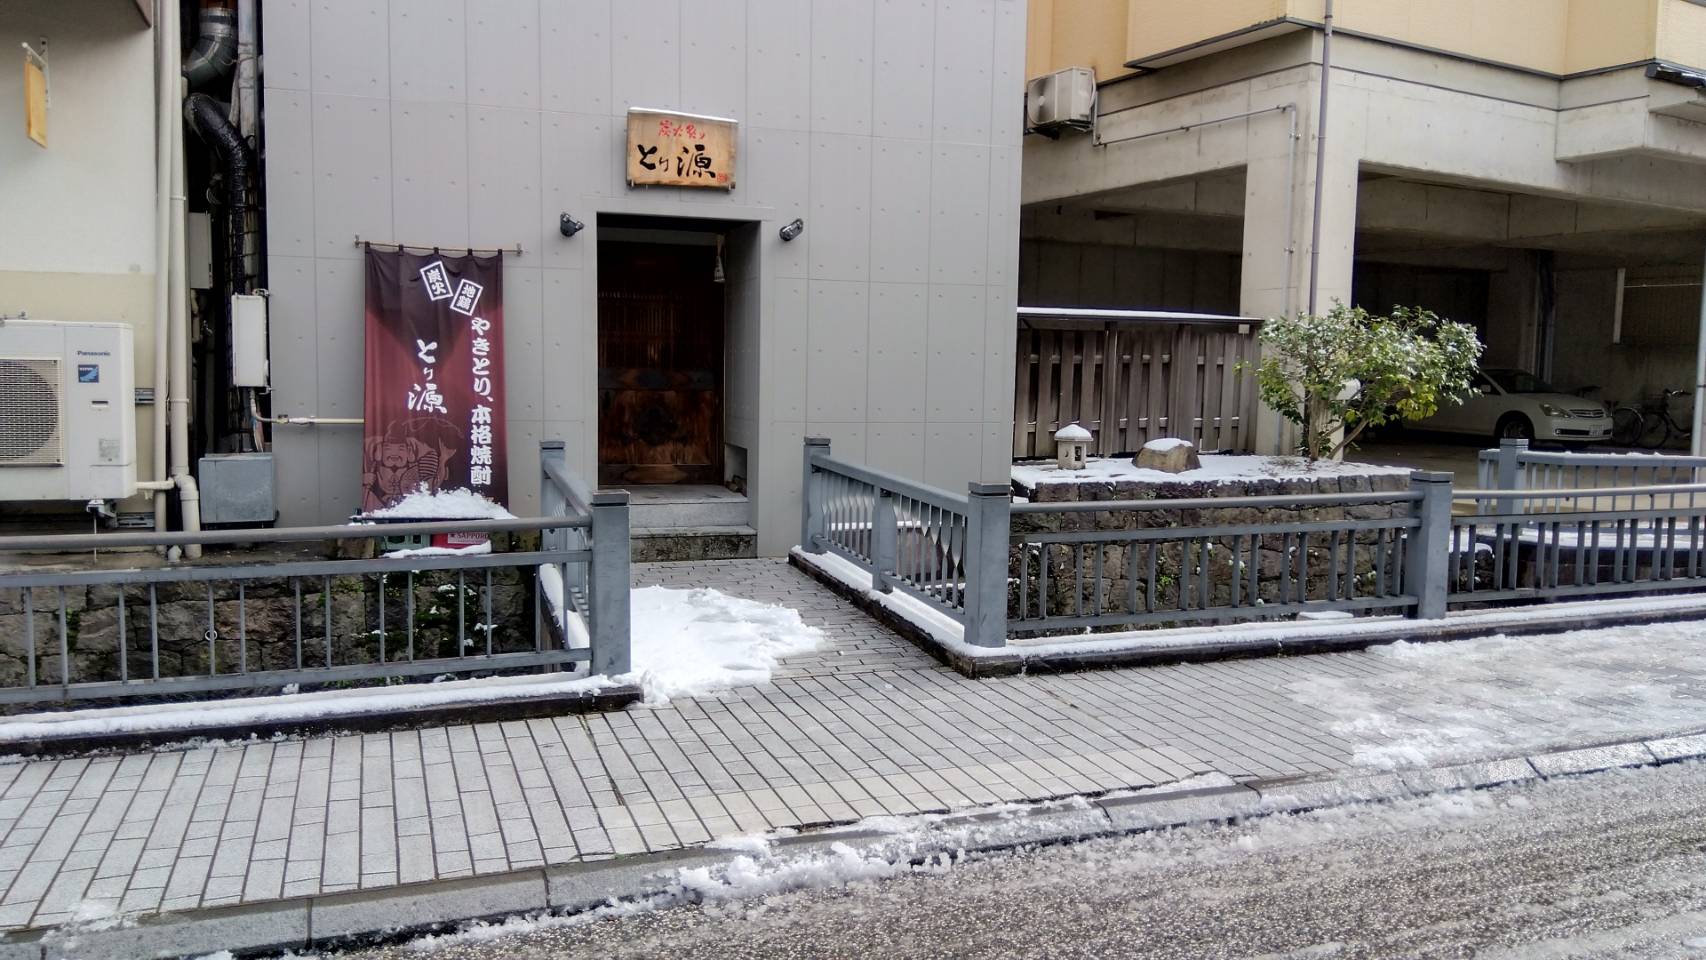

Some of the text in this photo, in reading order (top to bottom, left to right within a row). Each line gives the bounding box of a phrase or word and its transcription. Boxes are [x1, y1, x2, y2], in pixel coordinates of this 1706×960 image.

[637, 144, 716, 178] とり源
[426, 268, 447, 296] 炭火
[407, 338, 448, 414] とり源
[470, 316, 494, 486] やきとり、本格焼酎
